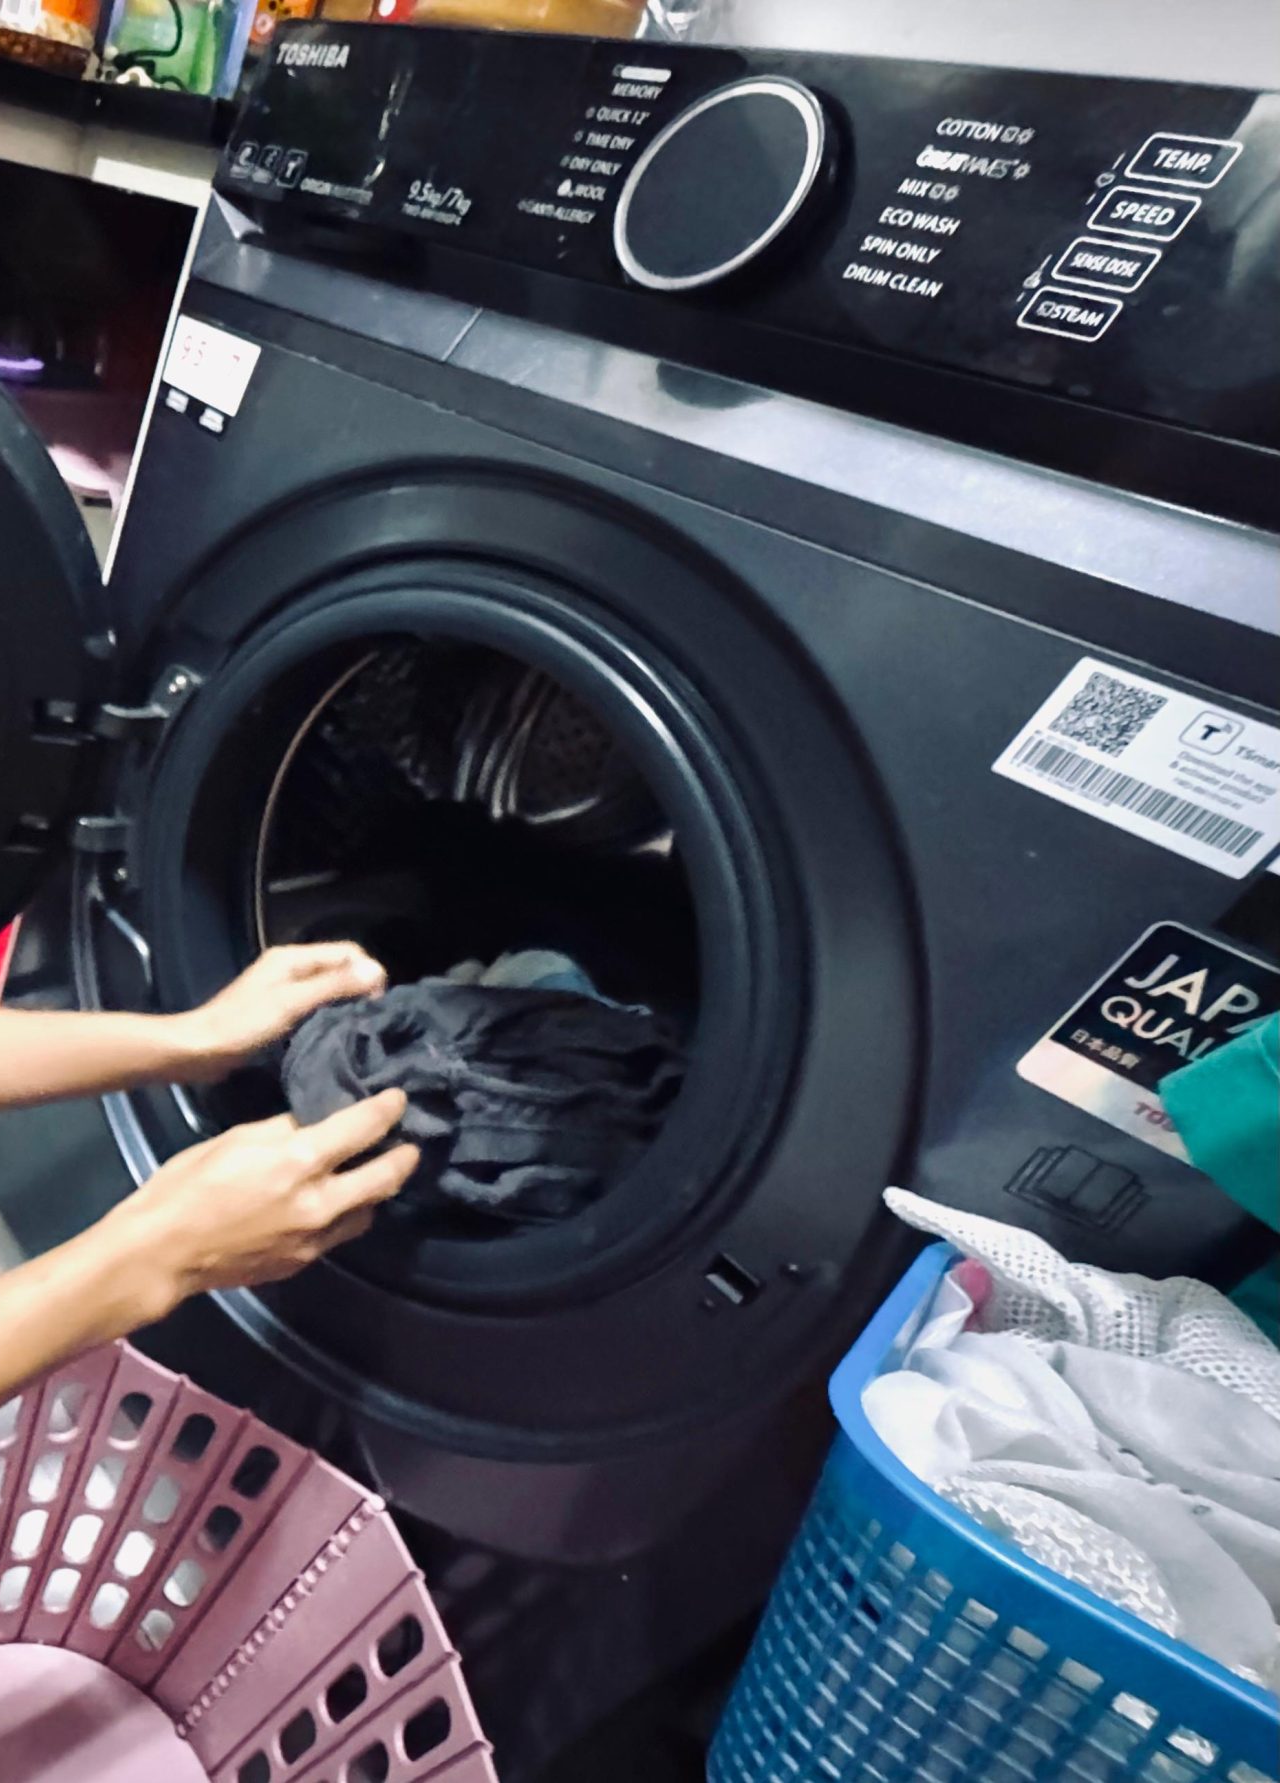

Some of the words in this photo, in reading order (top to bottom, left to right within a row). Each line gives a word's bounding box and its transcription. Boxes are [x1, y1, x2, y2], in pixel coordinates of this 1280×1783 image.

[276, 43, 350, 68] TOSHIBA
[612, 83, 663, 99] MEMORY
[596, 106, 632, 123] QUICK
[585, 132, 612, 149] TIME
[609, 136, 635, 150] DRY
[936, 117, 1003, 142] COTTON
[569, 156, 592, 171] DRY
[590, 160, 622, 175] ONLY
[1153, 148, 1213, 173] TEMP.
[575, 184, 606, 201] WOOL
[897, 178, 931, 197] MIX
[879, 206, 913, 226] ECO
[913, 212, 960, 236] WASH
[1110, 201, 1176, 225] SPEED
[860, 235, 897, 256] SPIN
[896, 242, 942, 264] ONLY
[843, 263, 892, 286] DRUM
[889, 273, 943, 298] CLEAN
[1050, 305, 1105, 327] STEAM
